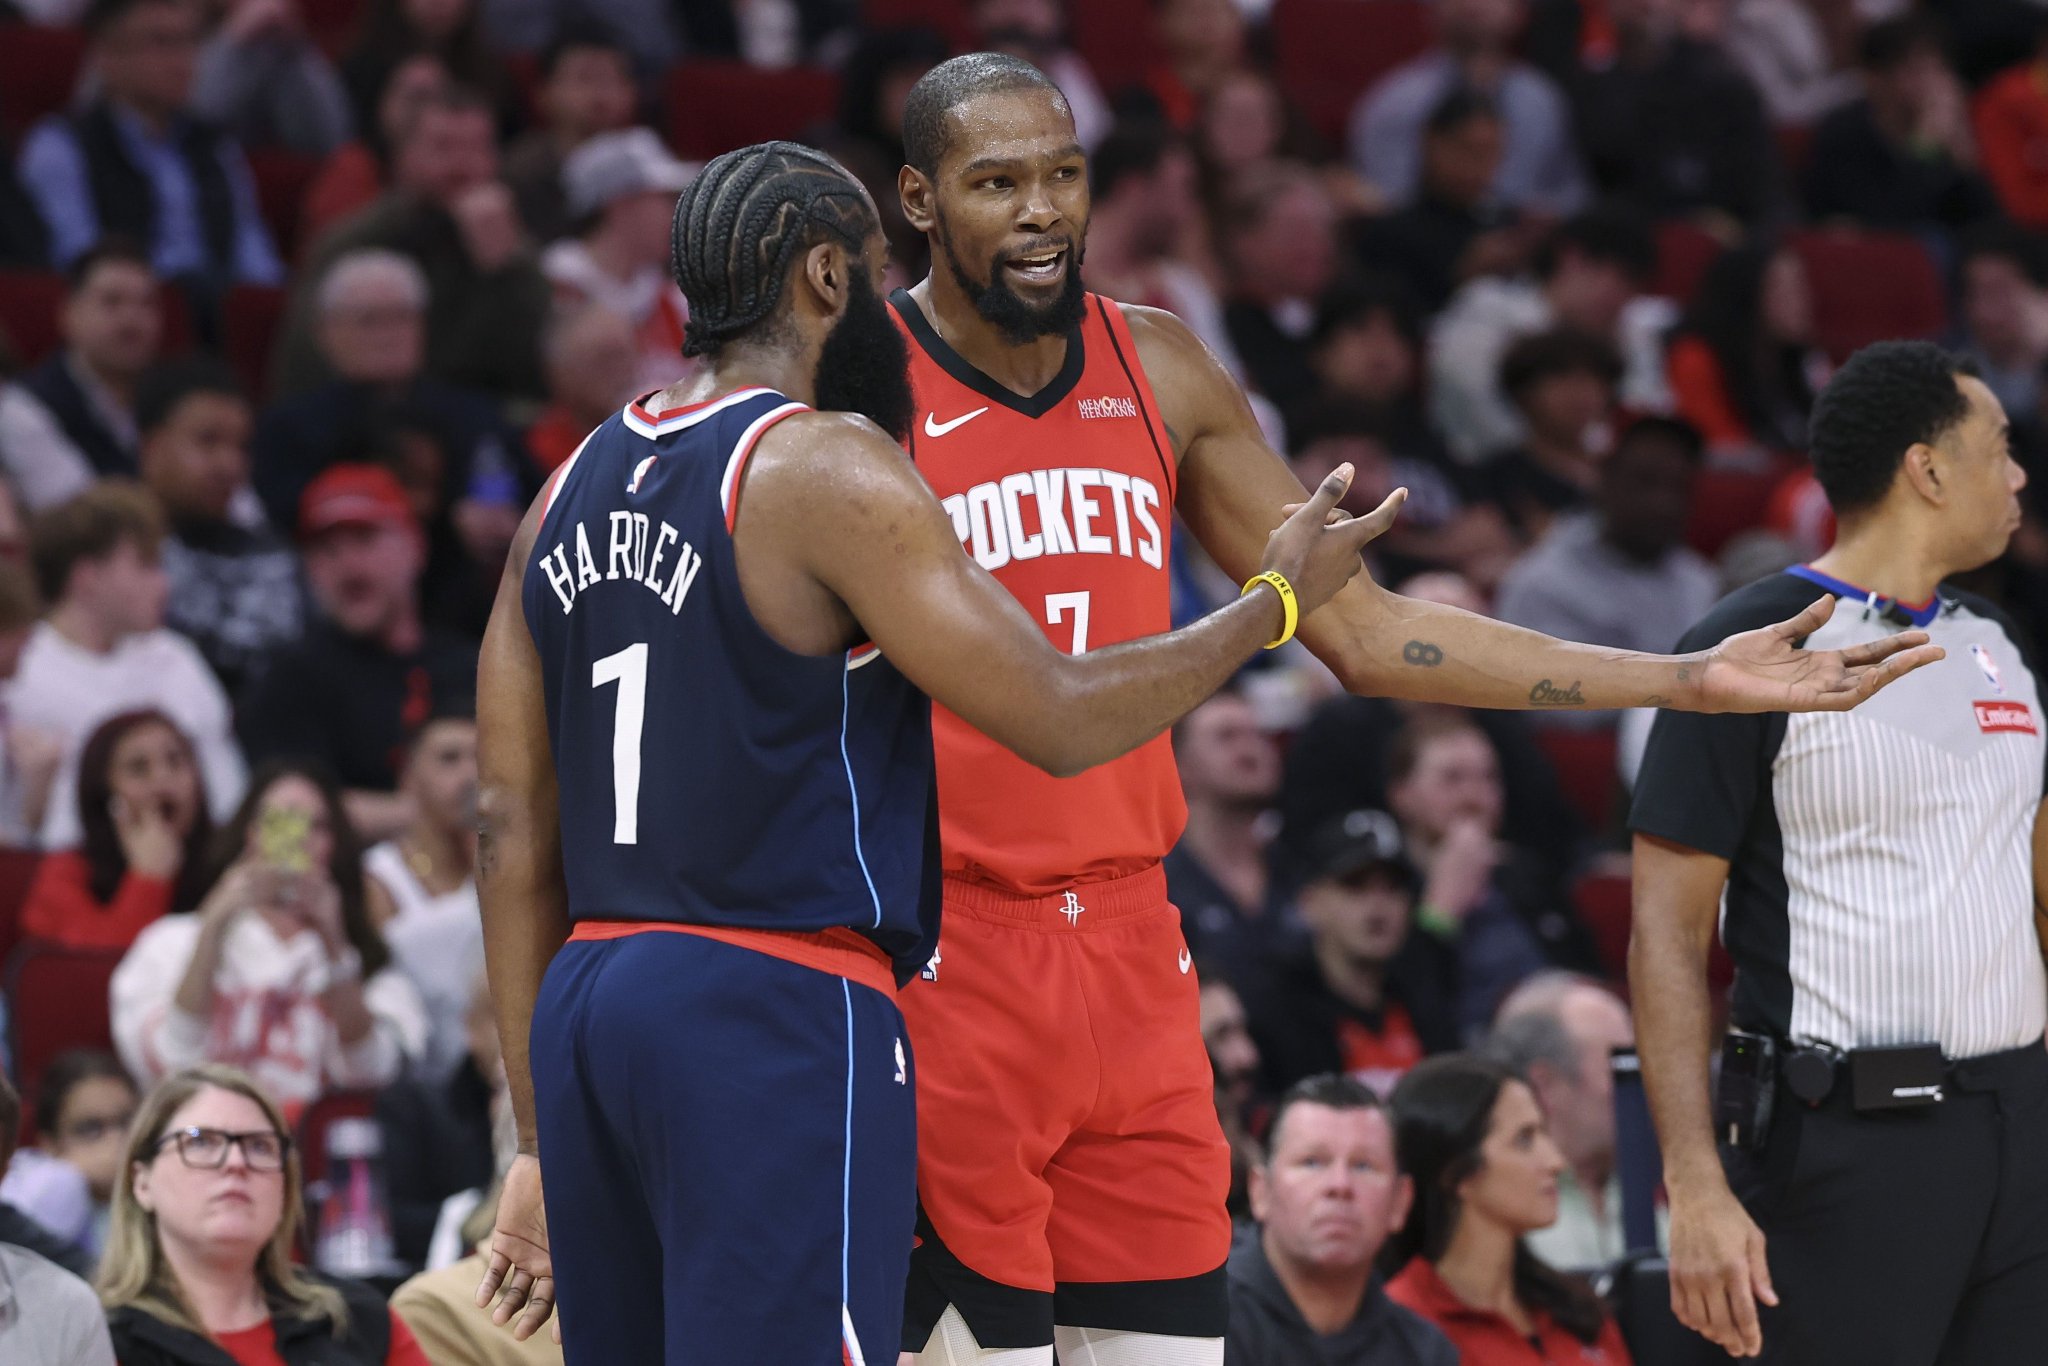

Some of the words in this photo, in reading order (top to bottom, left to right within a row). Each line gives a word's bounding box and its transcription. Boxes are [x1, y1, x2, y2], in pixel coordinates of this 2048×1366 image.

[1077, 395, 1136, 411] MEMORIAL
[1079, 405, 1137, 419] HERMANN
[538, 510, 702, 616] HARDEN
[1044, 590, 1091, 657] 7
[1529, 679, 1585, 706] Owls
[591, 642, 649, 845] 1
